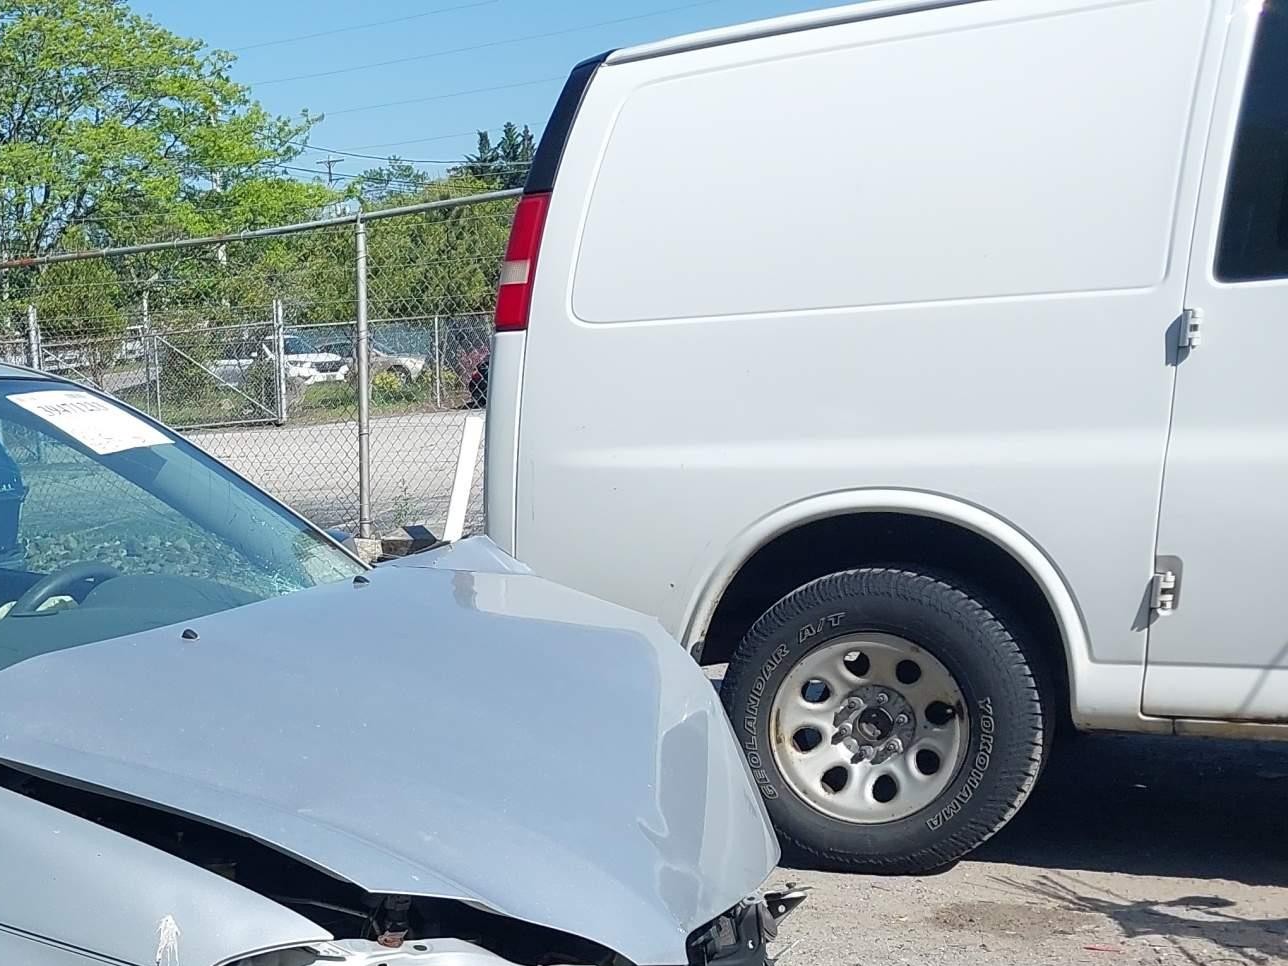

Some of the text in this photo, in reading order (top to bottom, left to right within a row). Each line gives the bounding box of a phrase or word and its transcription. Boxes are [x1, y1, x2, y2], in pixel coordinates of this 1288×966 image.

[744, 612, 847, 800] GEOLANDAR A/T
[927, 697, 995, 831] YOKOHAMA
